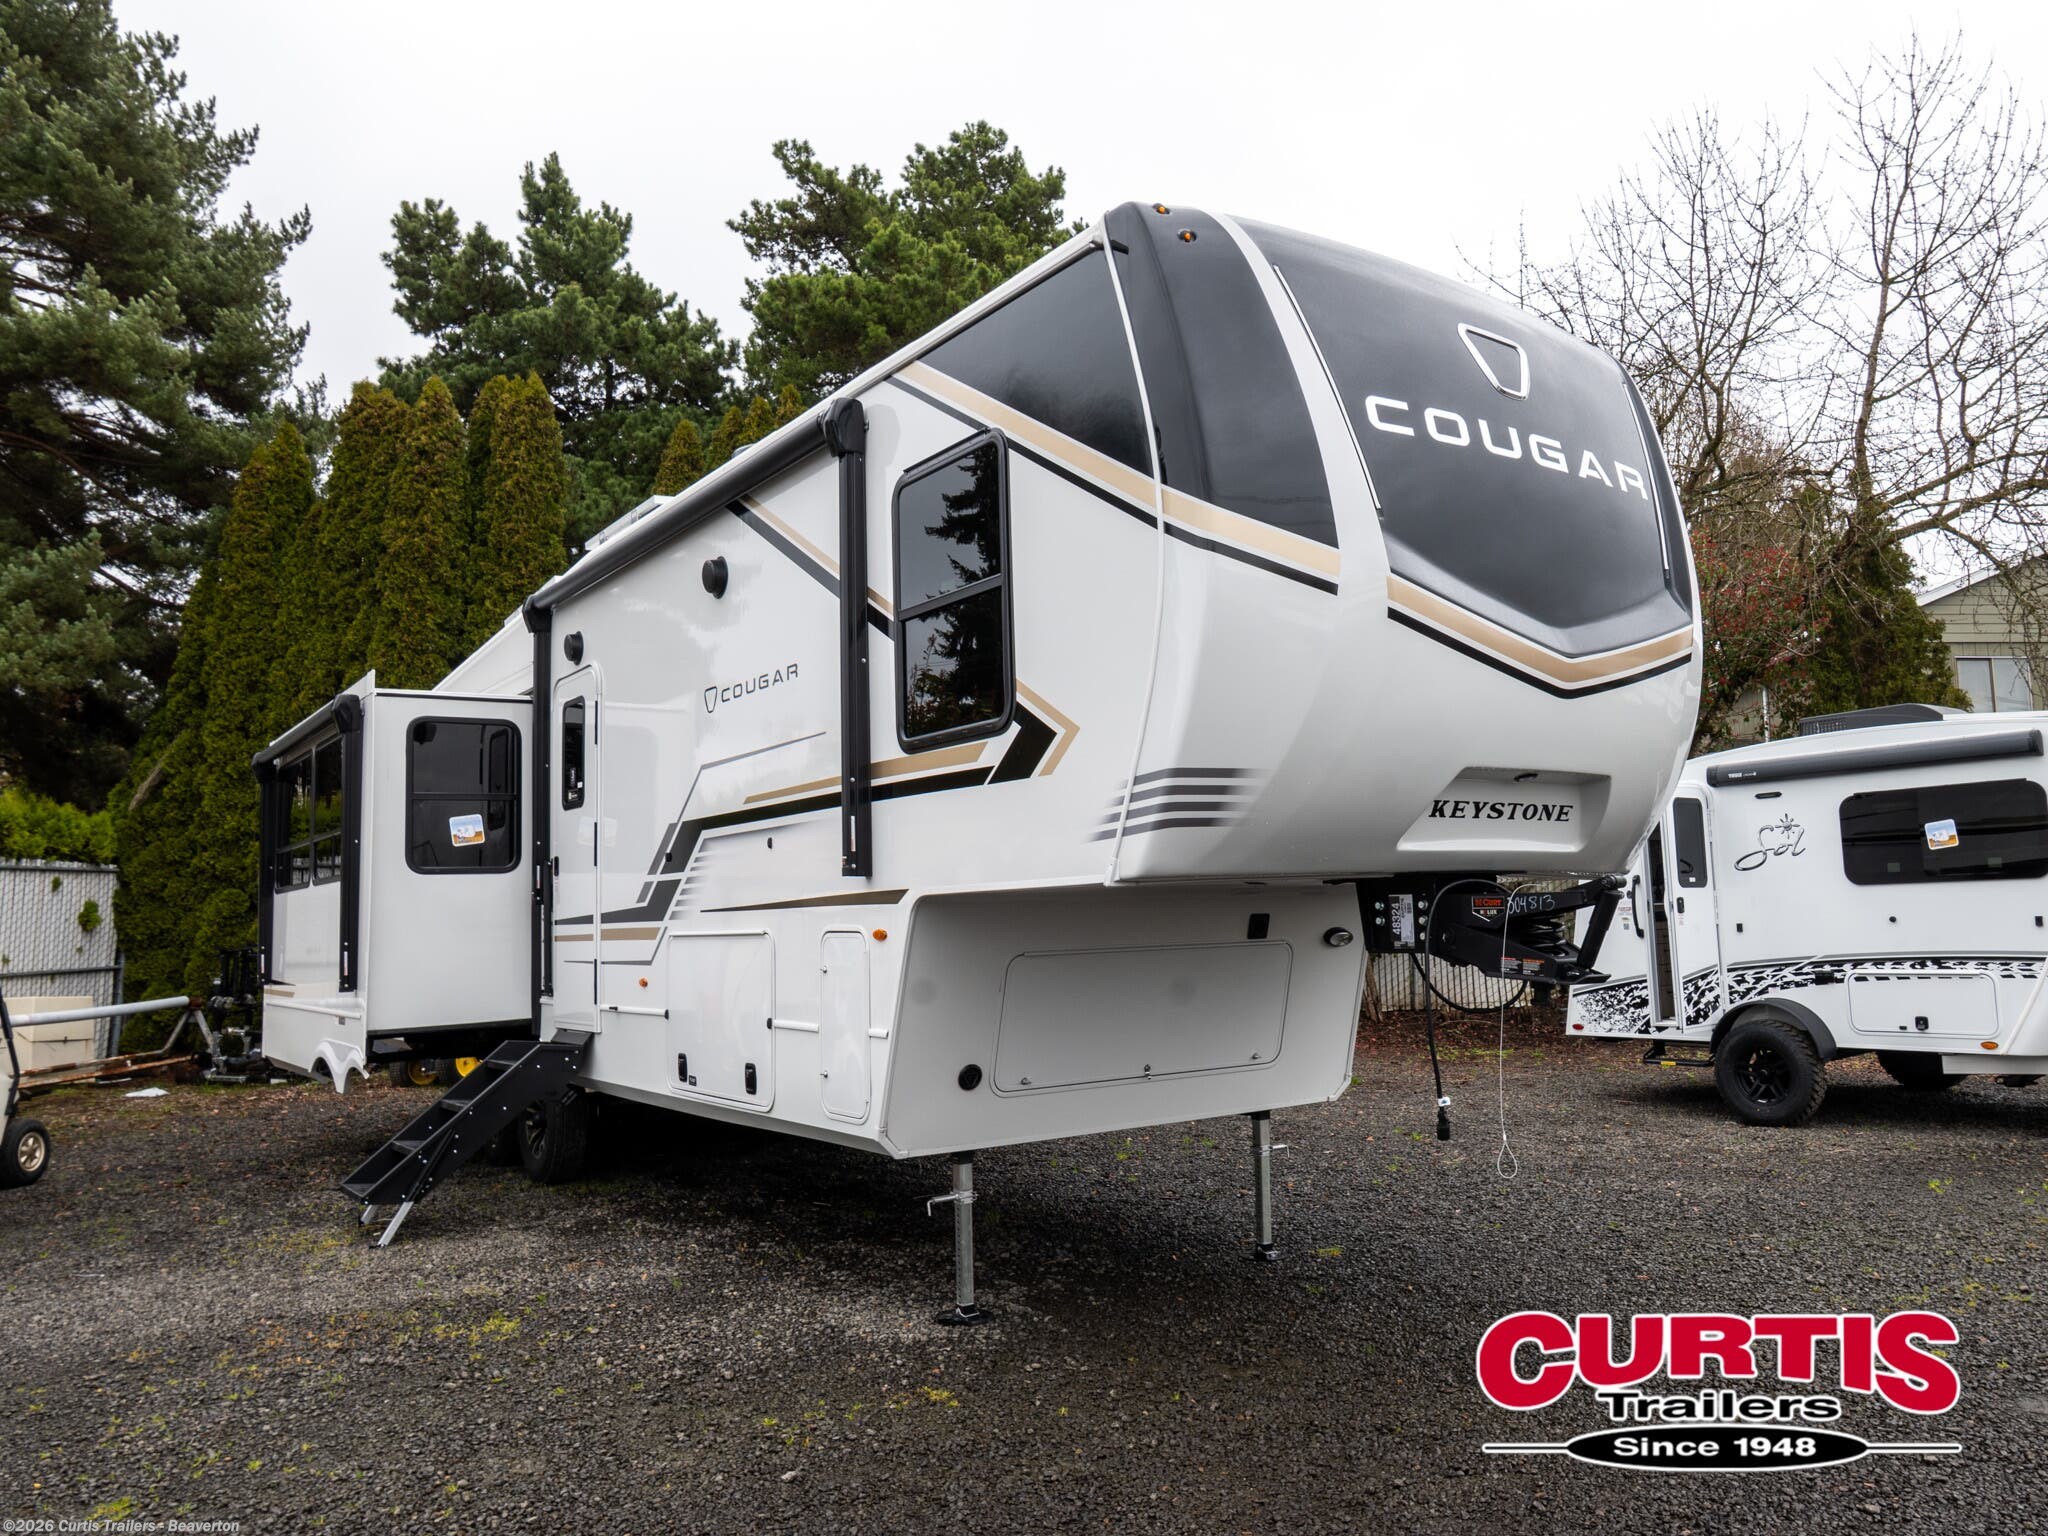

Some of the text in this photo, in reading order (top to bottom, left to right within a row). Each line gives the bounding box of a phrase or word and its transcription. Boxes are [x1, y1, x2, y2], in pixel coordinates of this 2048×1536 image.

[1365, 395, 1649, 500] COUGAR
[721, 663, 798, 703] COUGAR
[1428, 800, 1574, 822] KEYSTONE
[1391, 903, 1401, 935] 48324
